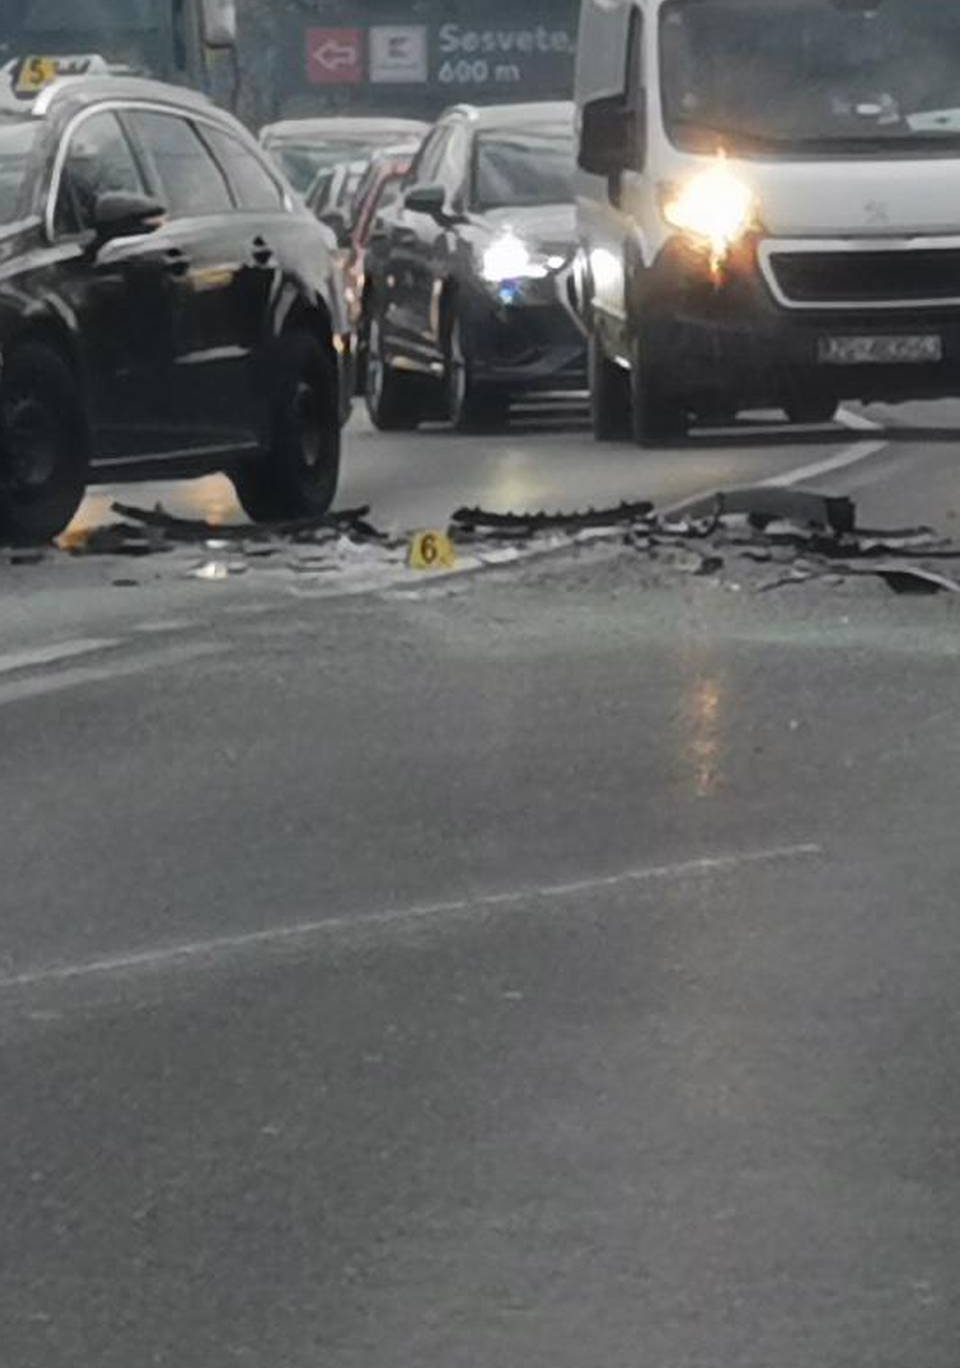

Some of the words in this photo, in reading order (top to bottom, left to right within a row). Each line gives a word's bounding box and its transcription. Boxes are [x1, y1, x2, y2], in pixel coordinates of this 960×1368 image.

[438, 59, 489, 83] 600
[494, 64, 521, 82] m
[421, 533, 438, 565] 6
